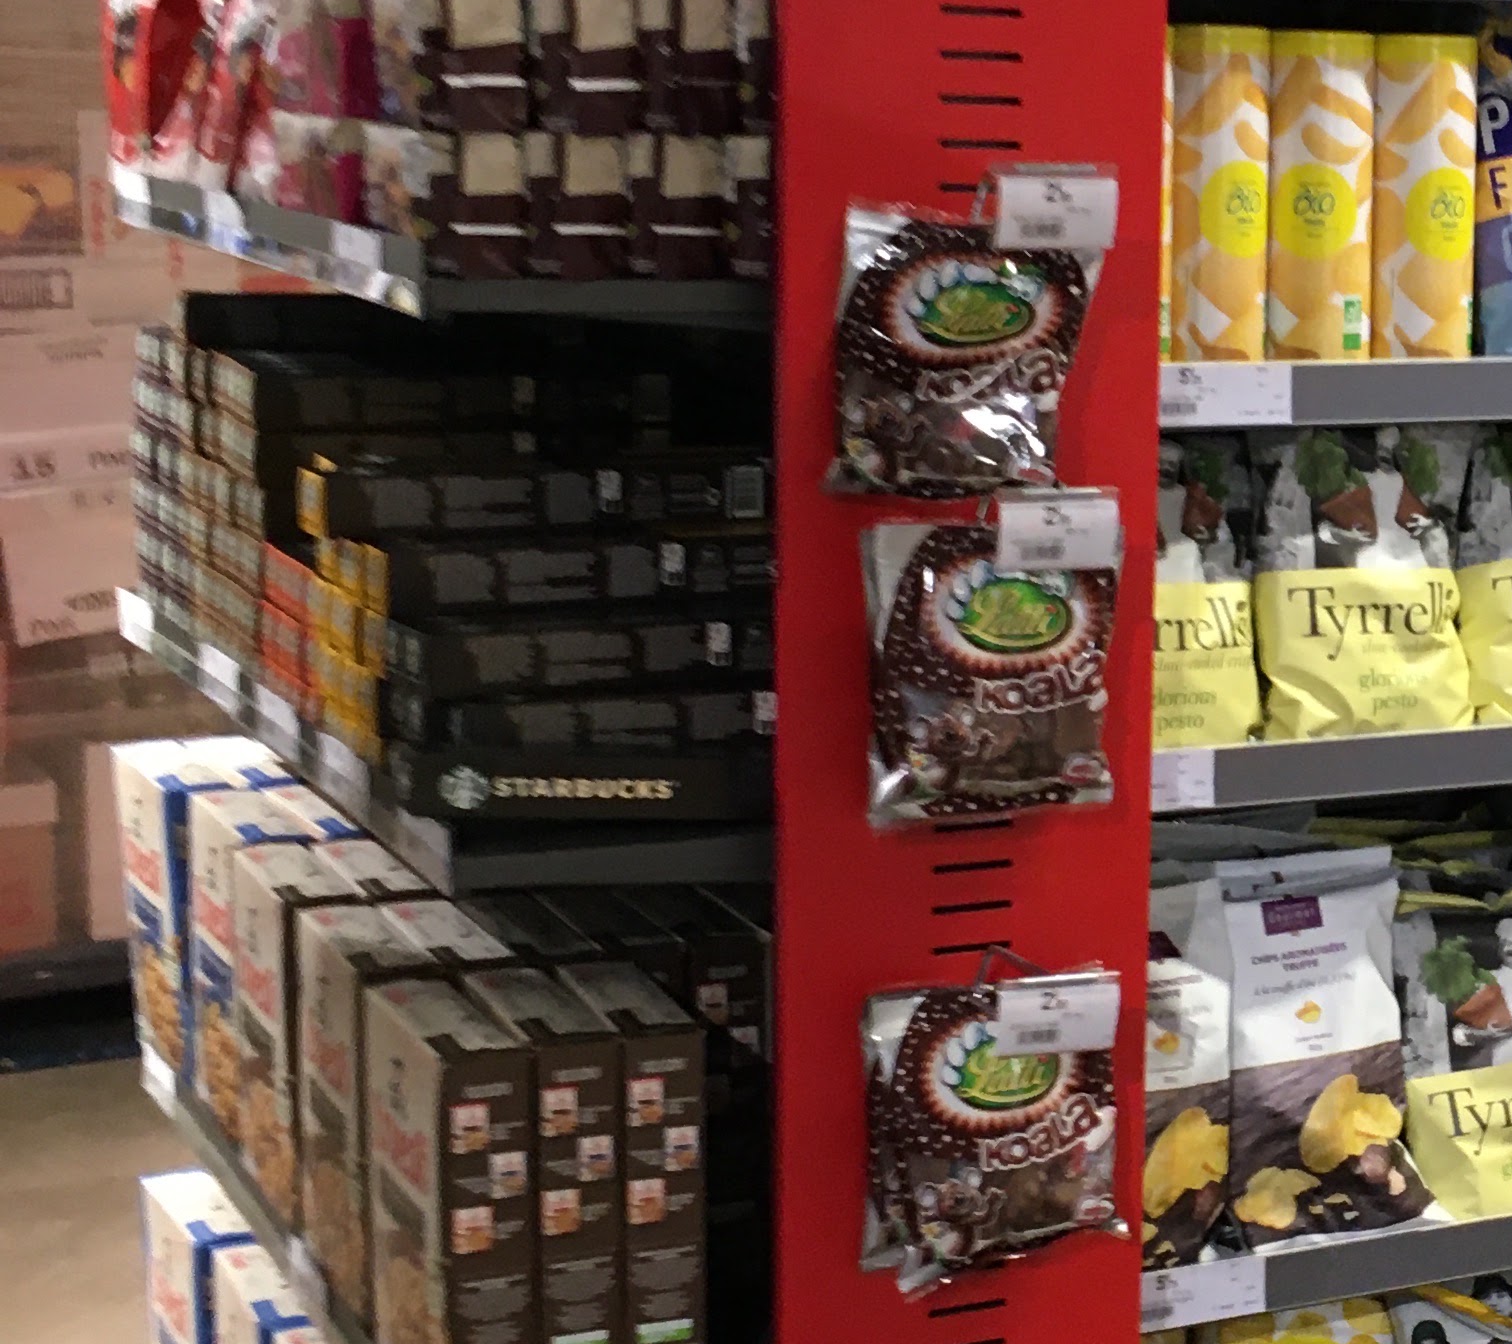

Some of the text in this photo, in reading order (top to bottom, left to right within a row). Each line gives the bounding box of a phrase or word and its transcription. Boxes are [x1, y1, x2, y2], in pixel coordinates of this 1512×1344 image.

[1153, 596, 1252, 652] rrell's
[1154, 687, 1218, 707] lorious
[490, 776, 676, 800] STARBUCKS
